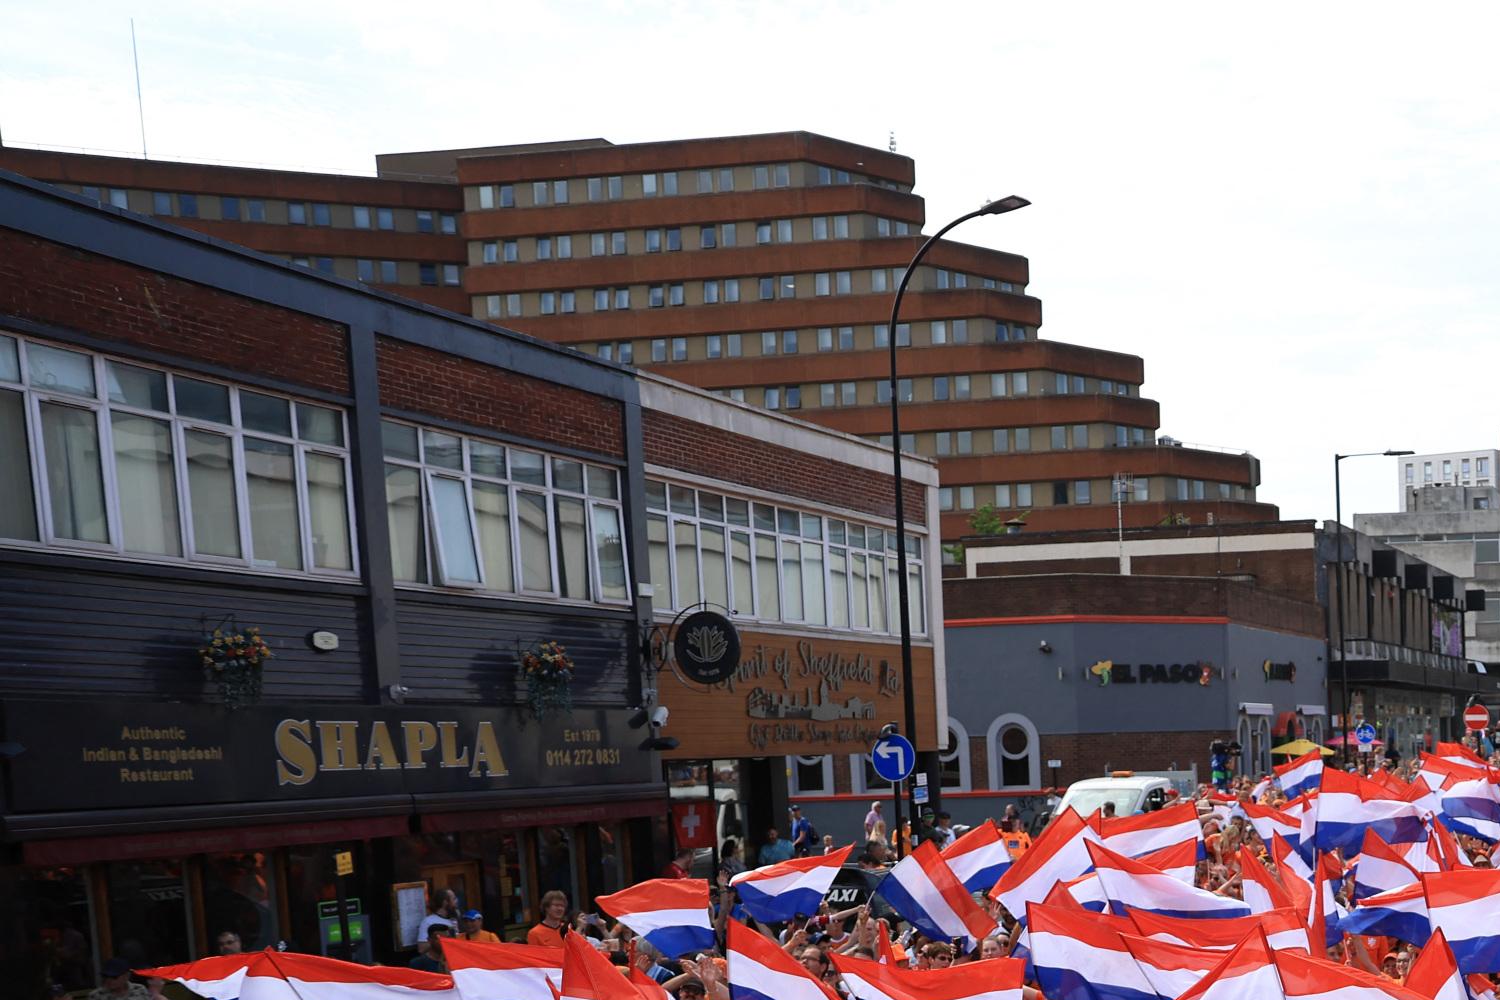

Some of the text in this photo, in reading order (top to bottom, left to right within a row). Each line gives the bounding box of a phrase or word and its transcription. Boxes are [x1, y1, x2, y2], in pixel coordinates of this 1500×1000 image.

[717, 644, 768, 693] pirit
[774, 648, 791, 688] of
[799, 639, 874, 692] Sheffield
[1112, 664, 1200, 684] EL PASO
[121, 726, 187, 740] Authentic
[83, 746, 223, 763] Indian & Bangladeshi
[275, 718, 508, 785] SHAPLA
[546, 748, 620, 766] 0114 272 0831
[120, 768, 194, 782] Restaurant
[825, 889, 859, 902] AXI
